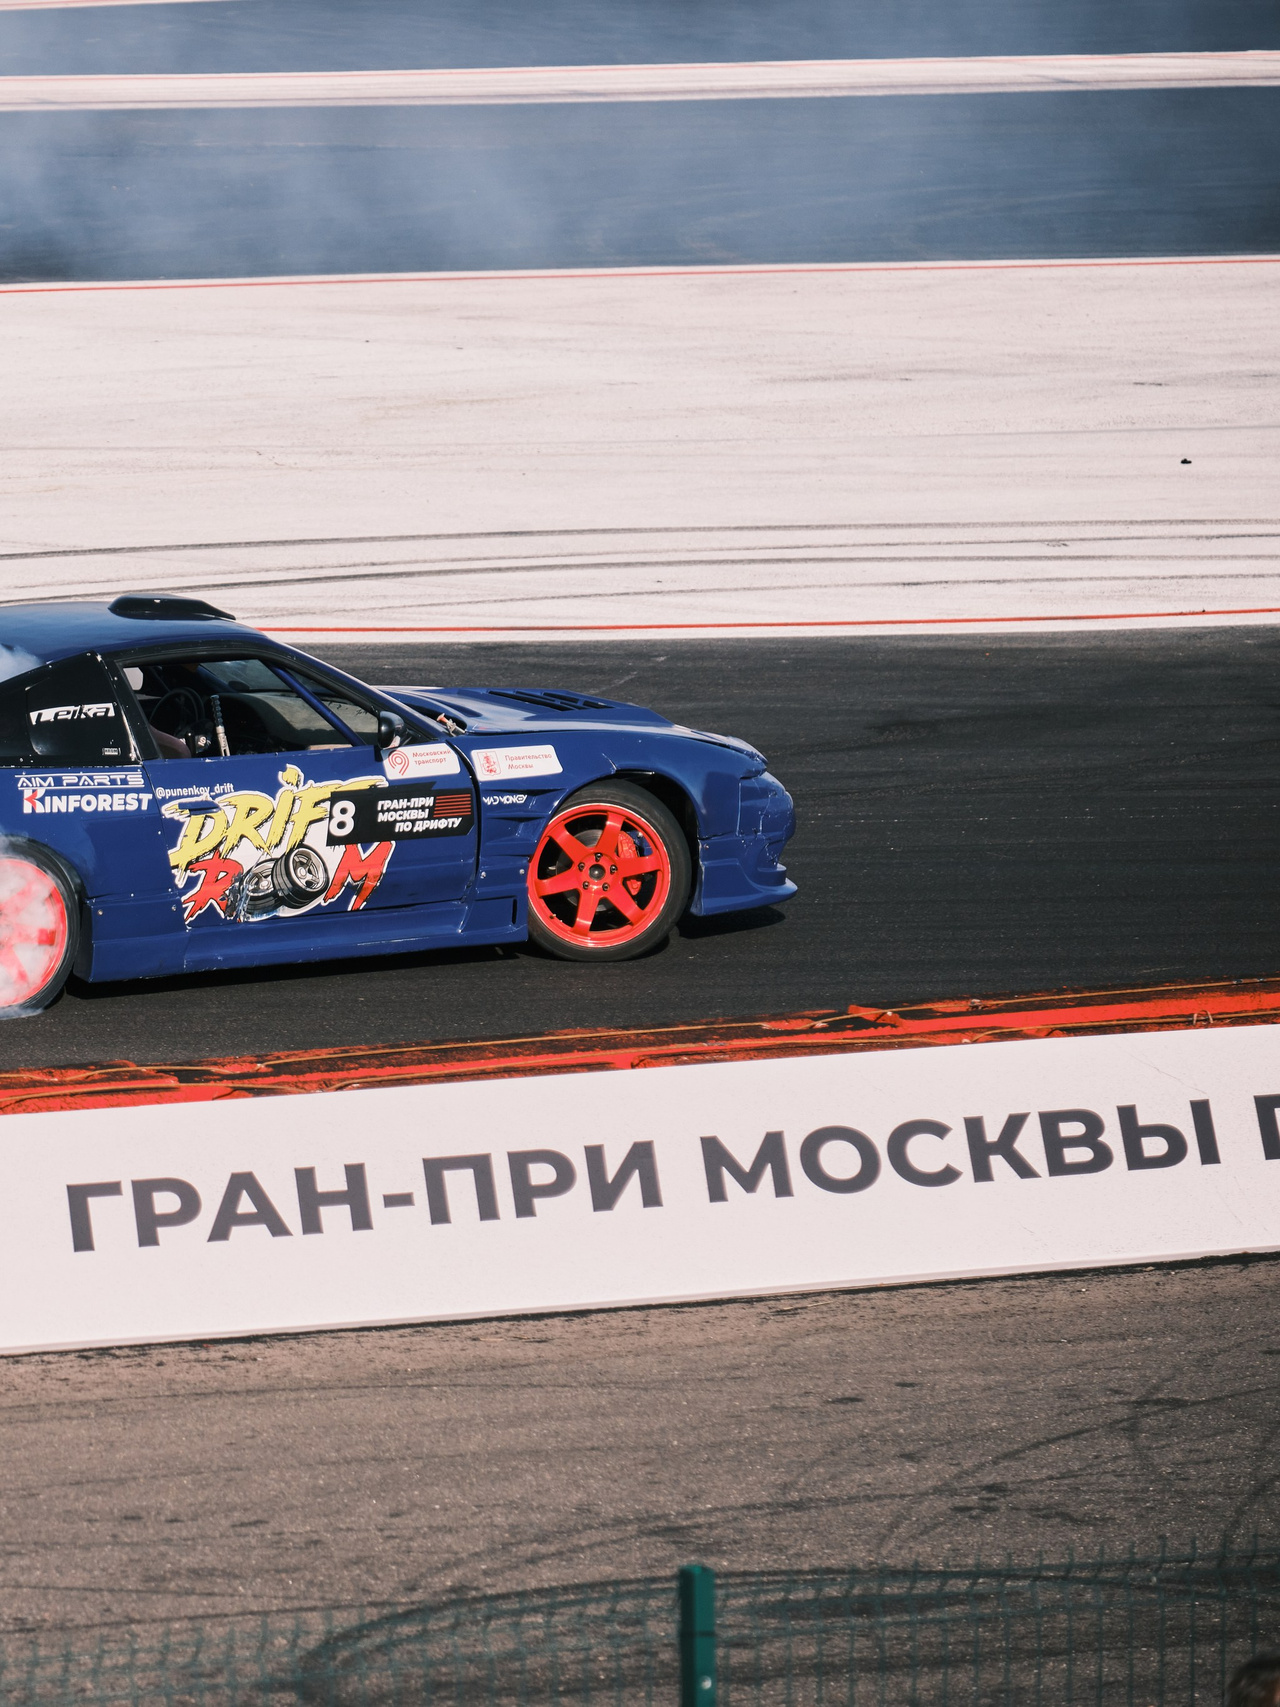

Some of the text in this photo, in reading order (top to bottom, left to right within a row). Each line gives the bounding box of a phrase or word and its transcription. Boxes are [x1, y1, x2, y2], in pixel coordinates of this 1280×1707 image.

[412, 750, 452, 758] Московский
[505, 753, 552, 763] Правительство
[414, 757, 447, 766] транспорт
[17, 775, 144, 787] AIM PARTS
[23, 788, 153, 814] KINFOREST
[377, 797, 435, 811] ГРАН-ПРИ
[329, 801, 356, 837] 8
[377, 809, 429, 822] МОСКВЫ
[395, 817, 463, 833] ПО ДРИФТУ
[66, 1140, 664, 1253] ГРАН-ПРИ
[700, 1098, 1222, 1203] МОСКВЫ
